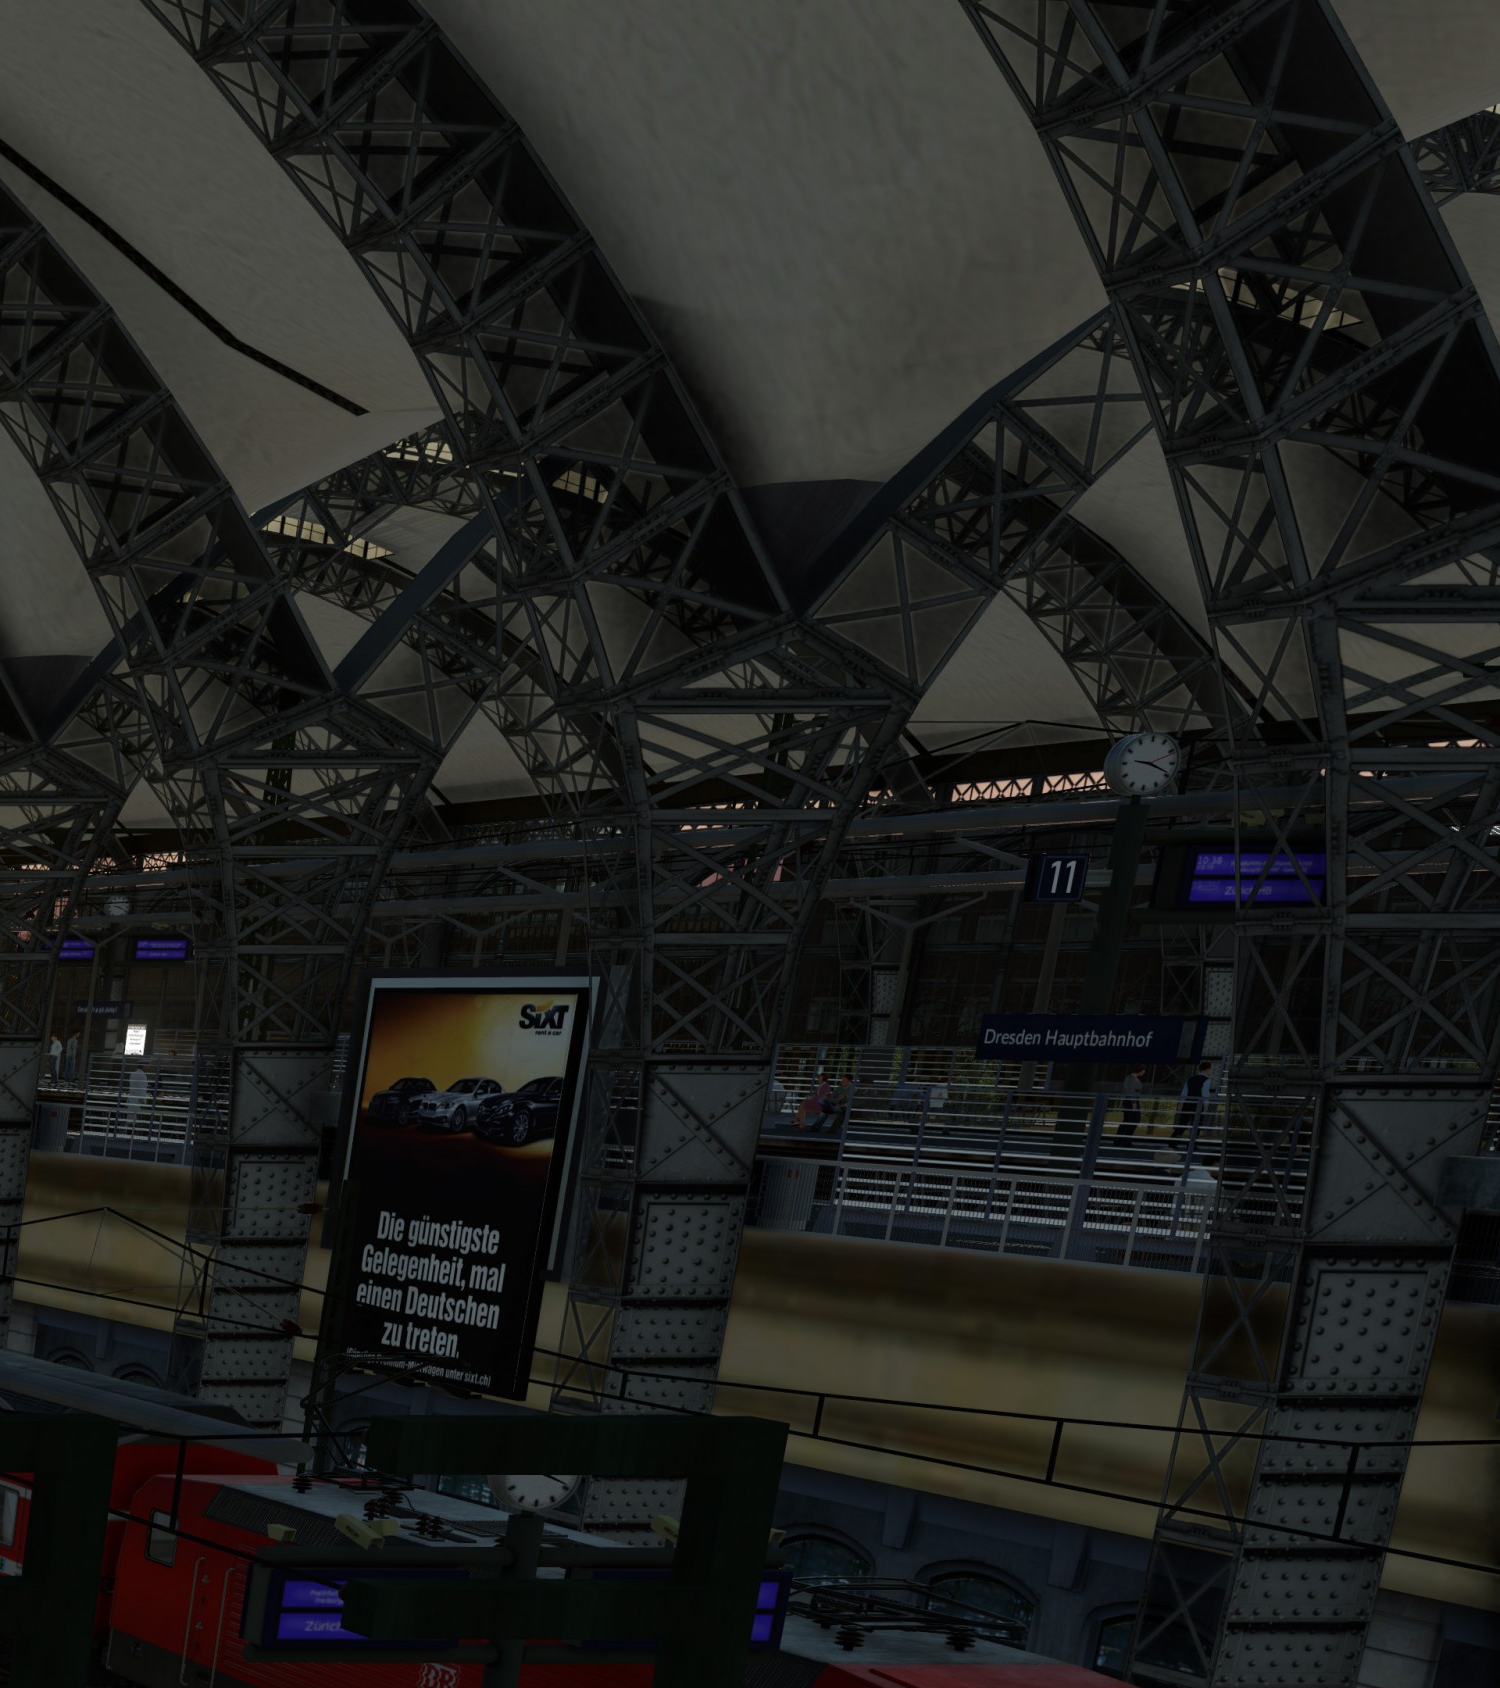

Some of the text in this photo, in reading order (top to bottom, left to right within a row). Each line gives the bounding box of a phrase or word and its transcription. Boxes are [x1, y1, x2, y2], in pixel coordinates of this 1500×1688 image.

[1050, 860, 1077, 893] 11
[983, 1028, 1155, 1049] Dresden Hauptbahnhof
[377, 1210, 500, 1255] Die günstigste
[361, 1243, 507, 1294] Gelegenheit, mal
[356, 1279, 500, 1330] einen Deutschen
[381, 1321, 403, 1348] zu
[405, 1321, 460, 1360] treten.
